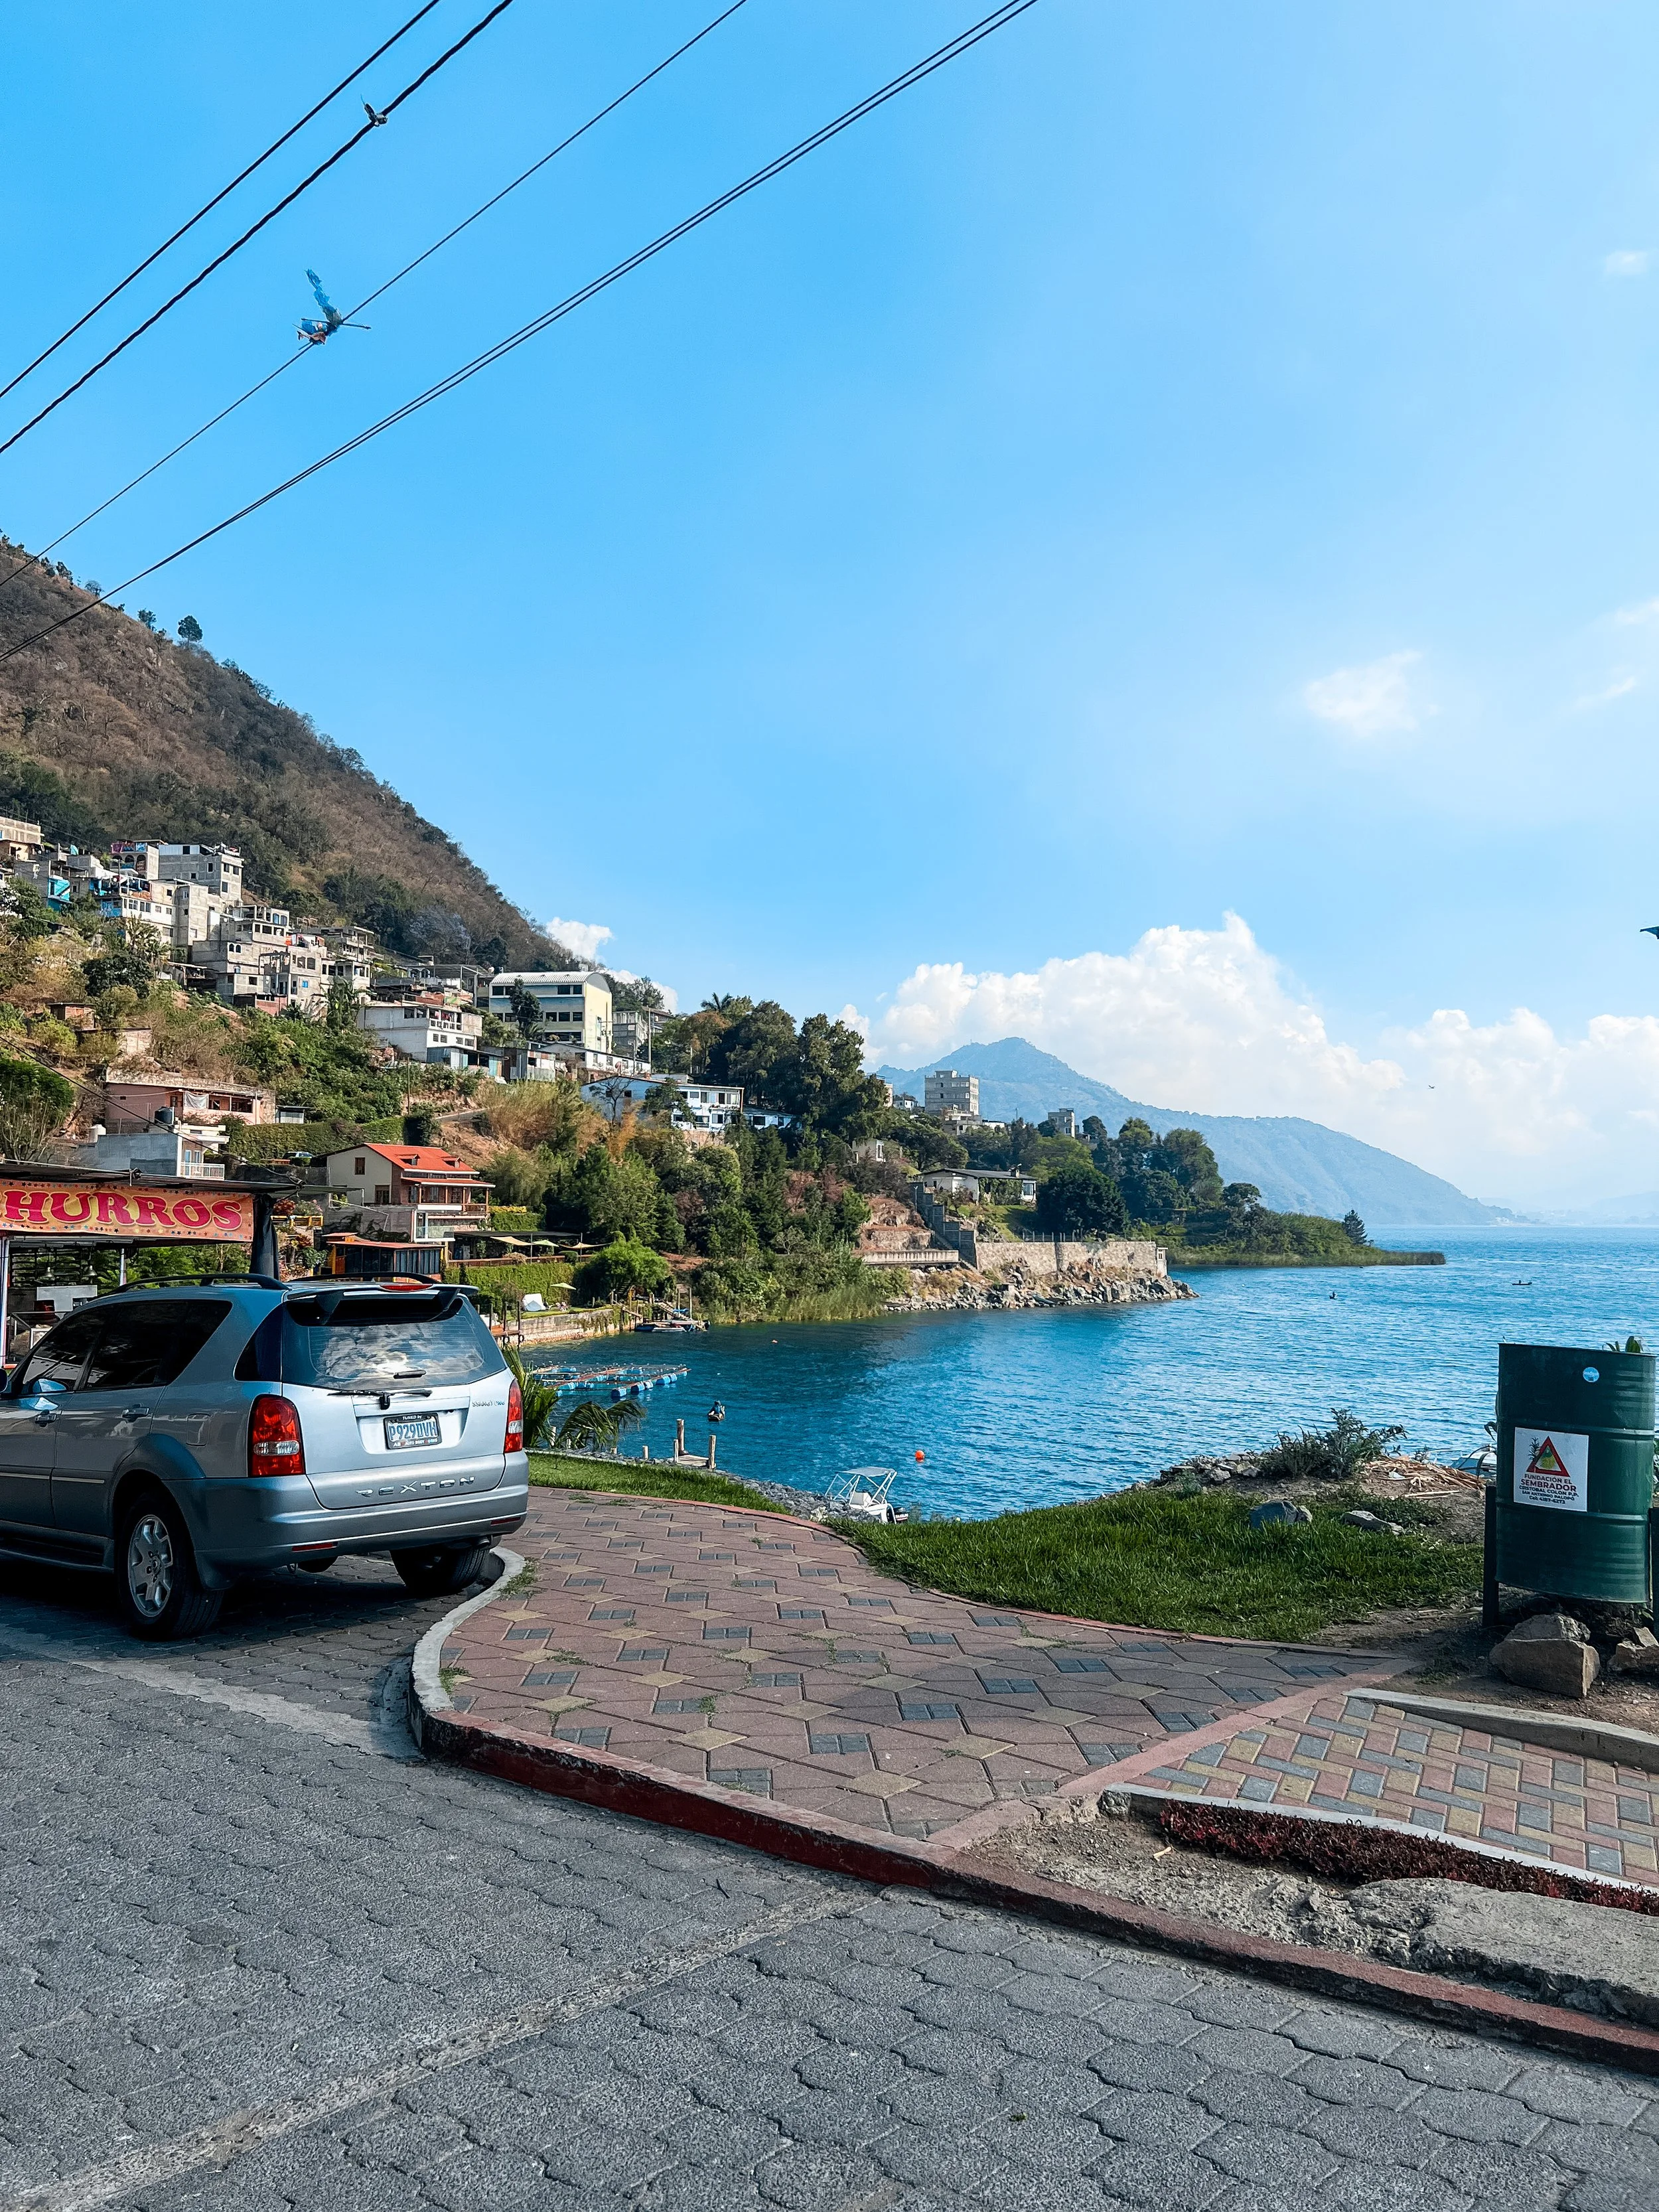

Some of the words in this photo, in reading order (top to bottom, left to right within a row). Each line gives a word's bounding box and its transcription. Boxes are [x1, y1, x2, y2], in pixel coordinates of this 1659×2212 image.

[0, 1190, 242, 1230] HURROS
[389, 1422, 438, 1440] P929DVH
[355, 1476, 475, 1498] REXTON
[1520, 1479, 1577, 1492] SEMBRADOR
